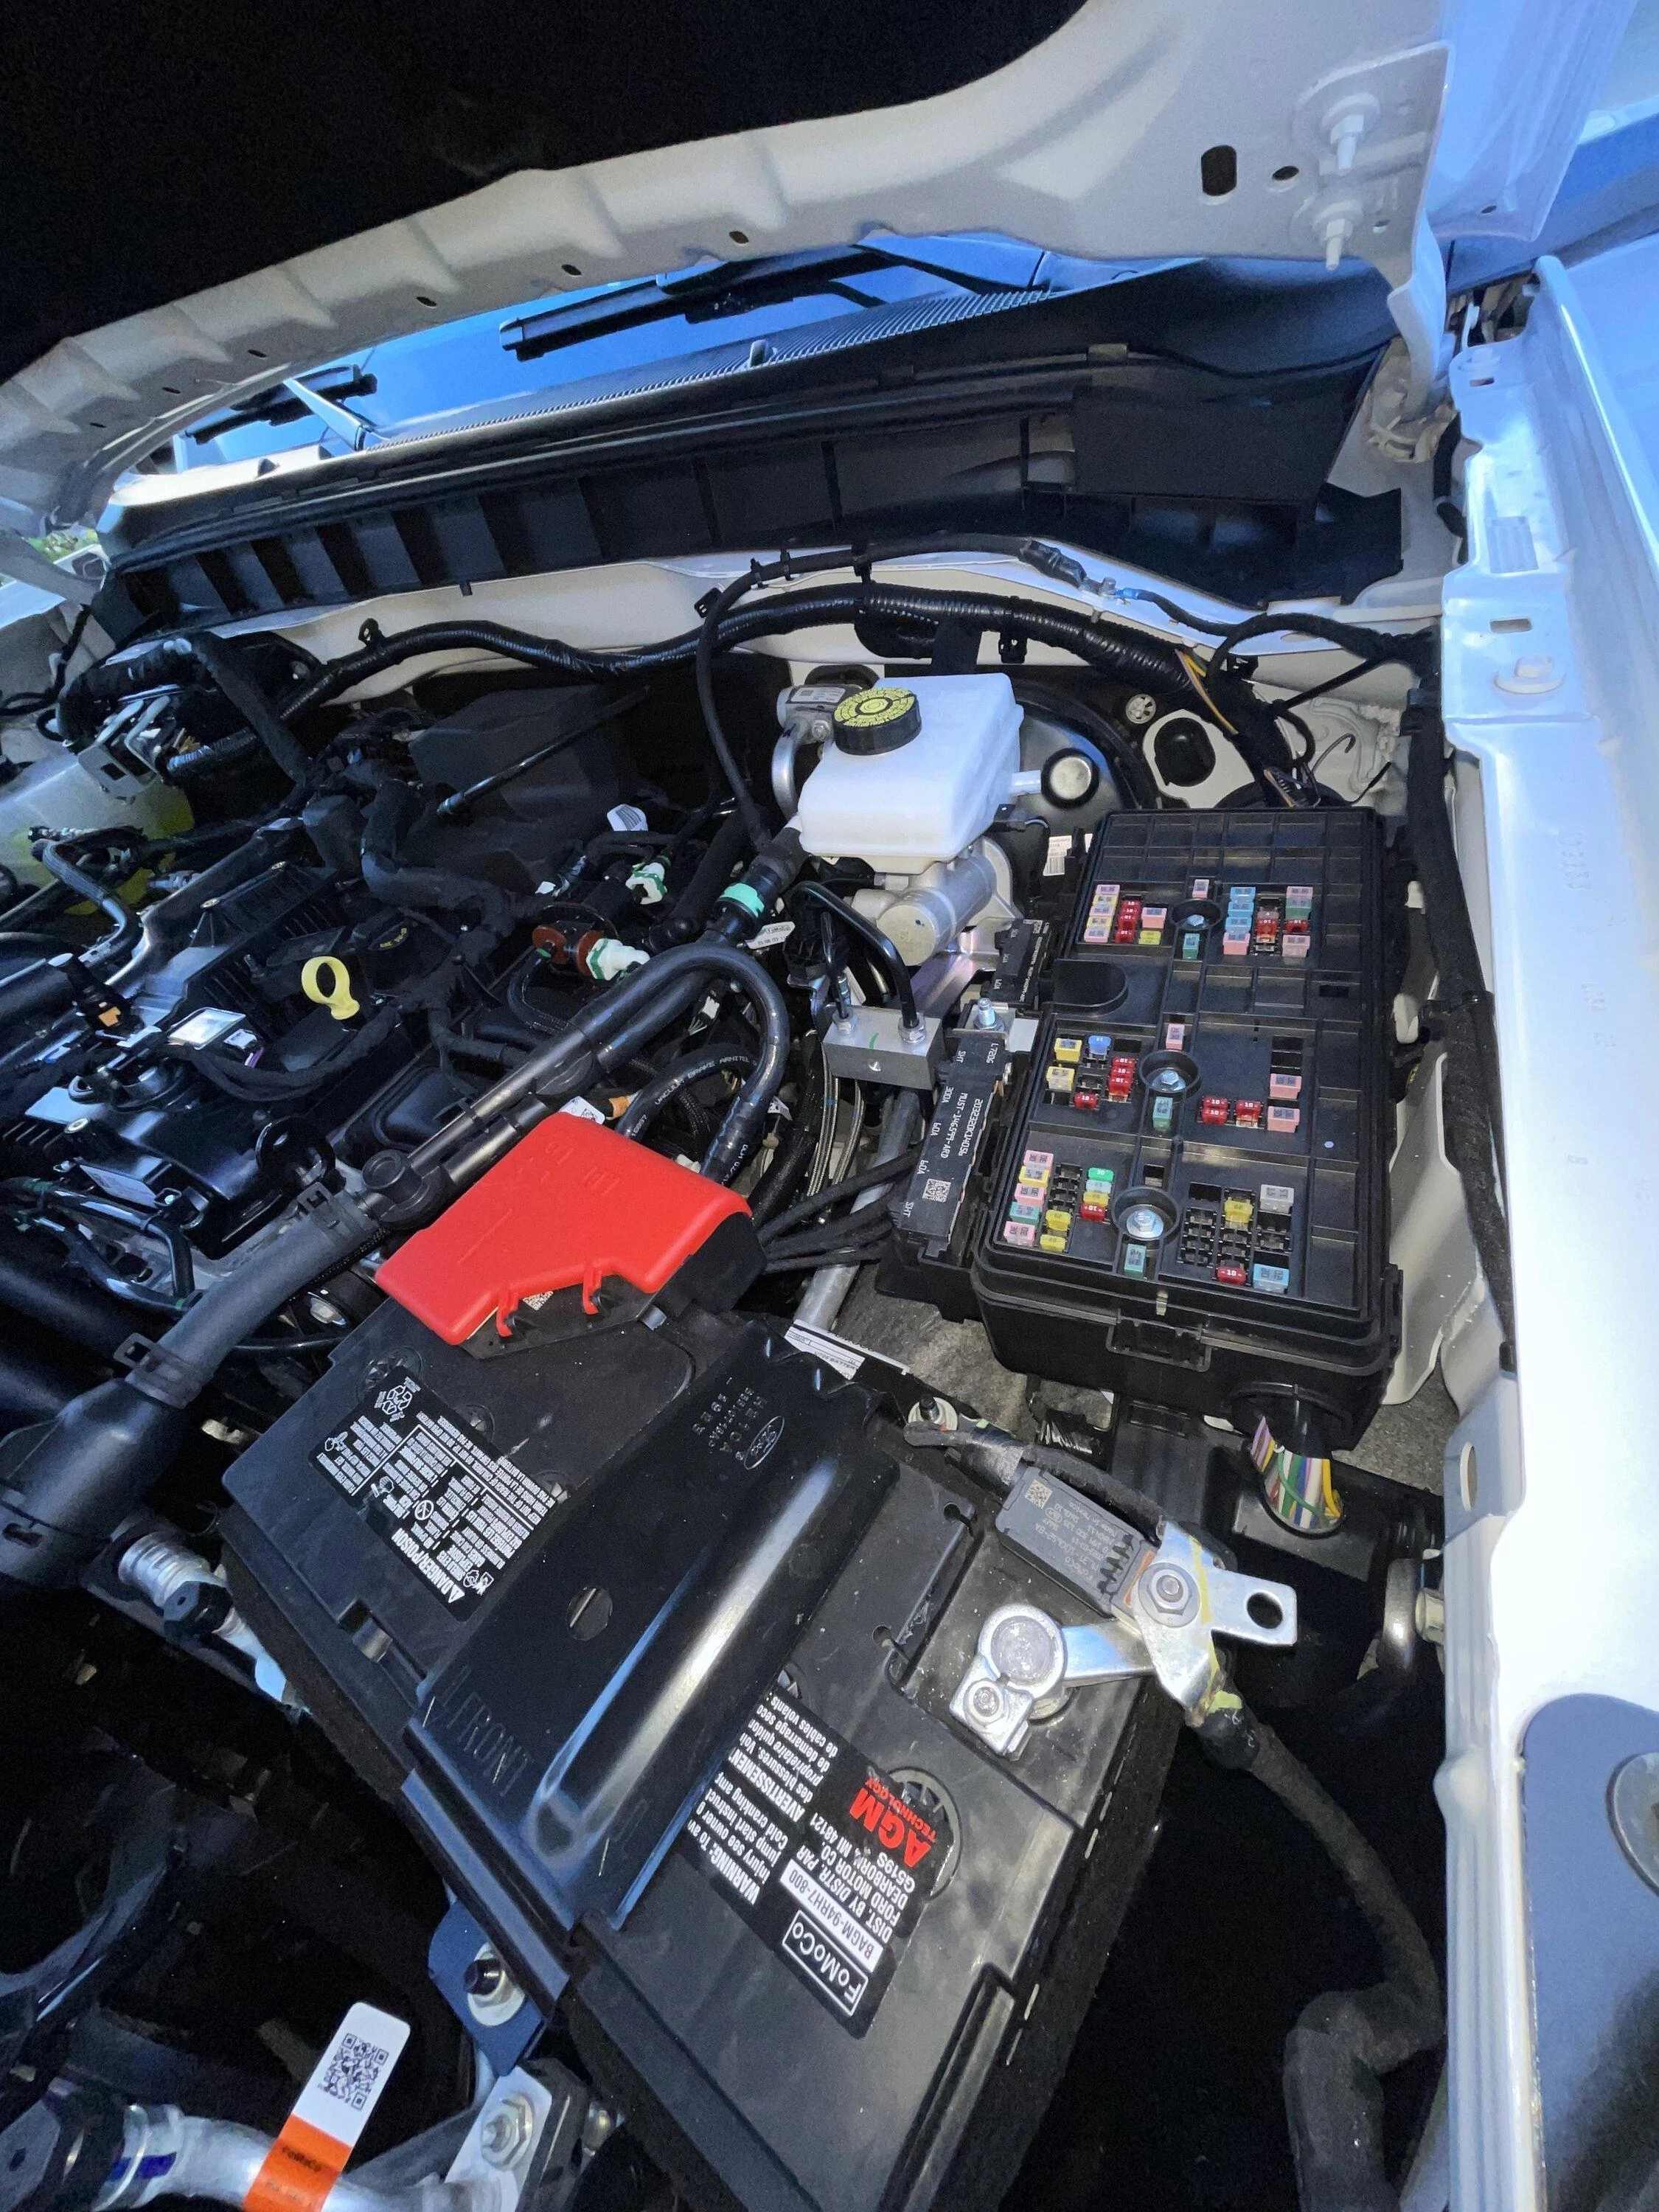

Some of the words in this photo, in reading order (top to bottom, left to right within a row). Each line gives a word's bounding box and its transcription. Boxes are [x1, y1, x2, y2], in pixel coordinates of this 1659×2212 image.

[688, 1061, 715, 1079] BRAKE
[940, 1086, 953, 1103] 300A
[505, 1492, 518, 1504] THE
[512, 1498, 524, 1509] OF
[514, 1484, 525, 1495] DE
[536, 1489, 549, 1503] PAS
[518, 1503, 532, 1517] OUT
[526, 1510, 542, 1526] KEEP
[1068, 1501, 1091, 1520] Mexico
[1099, 1523, 1117, 1537] Made
[390, 1526, 456, 1595] DANGER/POISON
[446, 1543, 473, 1573] EXPLOSIVE
[769, 1693, 801, 1728] volants
[773, 1717, 820, 1766] demarrage
[796, 1717, 827, 1750] cables
[772, 1736, 823, 1790] proprietaire
[815, 1755, 831, 1775] de
[823, 1739, 839, 1761] de
[754, 1744, 798, 1792] blessures.
[730, 1785, 770, 1831] cranking
[793, 1781, 814, 1806] des
[864, 1773, 936, 1842] TECHNOLOGY
[697, 1829, 712, 1851] To
[700, 1806, 729, 1843] owner
[734, 1815, 757, 1846] start
[765, 1820, 789, 1851] Cold
[809, 1810, 839, 1846] 48121
[848, 1784, 930, 1874] AGM
[726, 1833, 745, 1858] see
[753, 1832, 781, 1868] jump
[795, 1842, 819, 1873] PAR
[817, 1840, 838, 1867] CO.
[836, 1835, 852, 1857] MI
[707, 1840, 761, 1905] WARNING:
[741, 1846, 772, 1885] injury
[833, 1855, 873, 1900] MOTOR
[875, 1849, 915, 1893] G519S
[815, 1863, 851, 1904] DISTR.
[787, 1866, 875, 1961] BAGM-94RH7-800
[848, 1893, 866, 1919] BY
[869, 1890, 900, 1926] FORD
[863, 1908, 891, 1944] DIST.
[787, 1917, 863, 2006] FoMoCo
